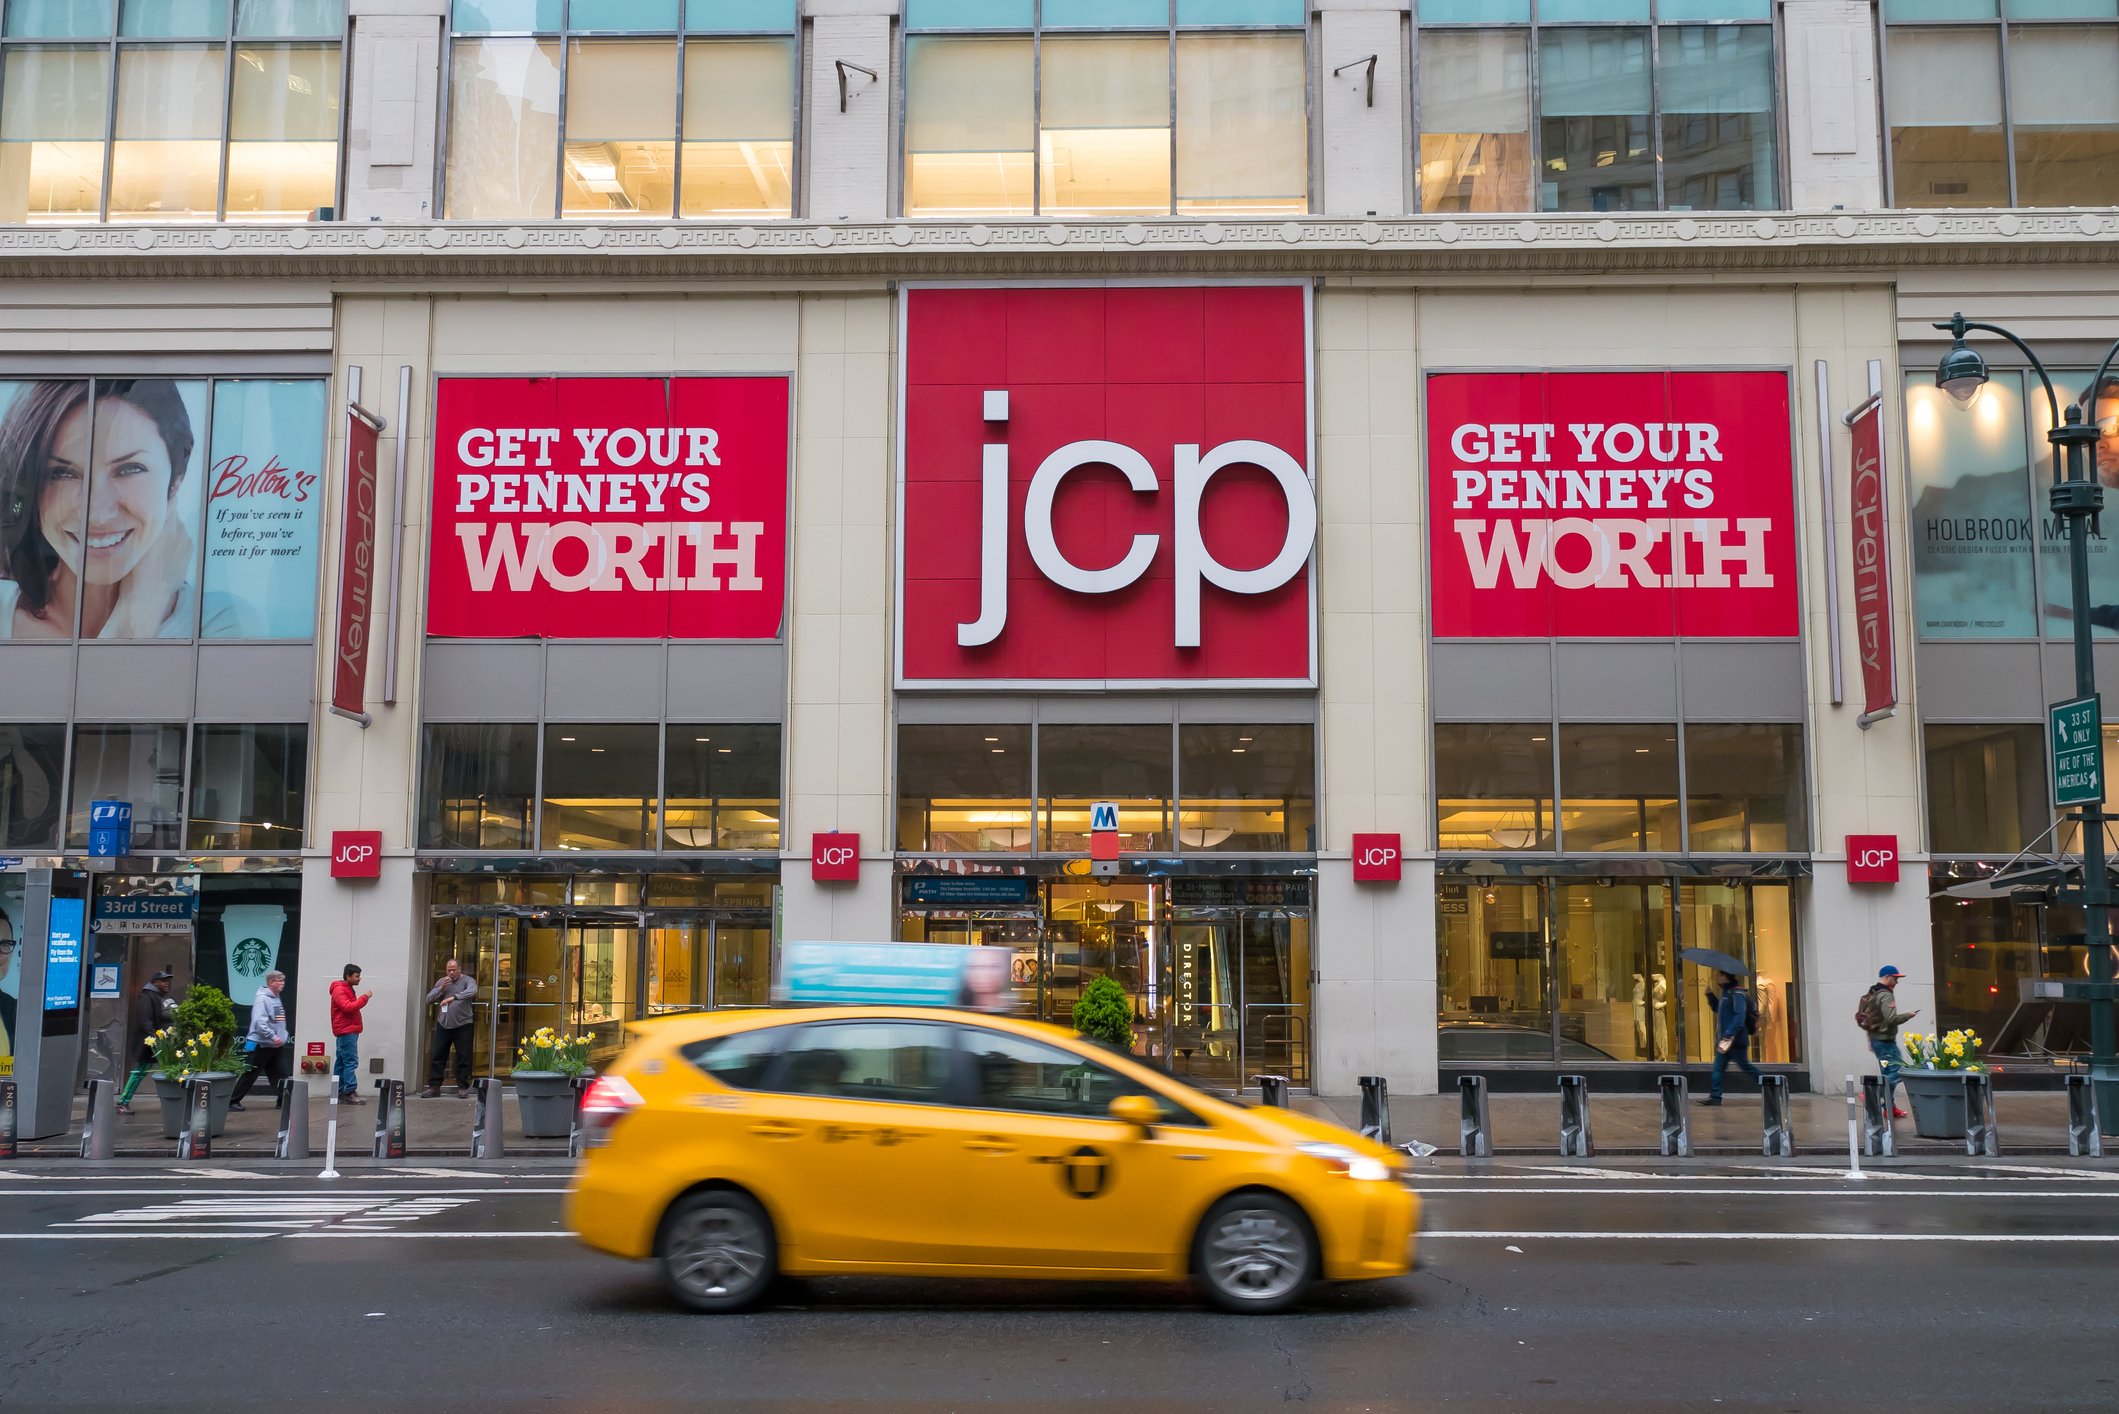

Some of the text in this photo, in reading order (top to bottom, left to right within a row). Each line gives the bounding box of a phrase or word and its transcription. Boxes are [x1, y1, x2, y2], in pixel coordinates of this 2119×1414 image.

[457, 427, 721, 468] GET YOUR
[1451, 422, 1723, 463] GET YOUR
[209, 454, 317, 504] Bolton's
[455, 471, 711, 513] PENNEY'S
[1452, 468, 1715, 509] PENNEY'S
[216, 508, 303, 523] If you've seen it
[957, 390, 1317, 648] jcp
[221, 527, 294, 542] before, you've
[1927, 517, 2108, 541] HOLBROOK MEAL
[212, 545, 302, 560] seen it for more!
[455, 520, 765, 592] WORTH
[1453, 517, 1774, 590] WORTH
[1958, 546, 1983, 554] DESIGN
[1985, 546, 2007, 554] FUSED
[2010, 546, 2027, 554] WITH
[341, 450, 375, 677] JCPenney
[2071, 710, 2091, 727] 33 ST
[2073, 728, 2090, 744] ONLY
[2059, 752, 2095, 771] AVE OF THE
[2058, 771, 2089, 789] AMERICAS
[335, 845, 373, 864] JCP
[816, 847, 854, 865] JCP
[1358, 848, 1397, 866] JCP
[1855, 849, 1894, 867] JCP
[104, 901, 184, 914] 33rd Street
[131, 922, 188, 930] To PATH Trains
